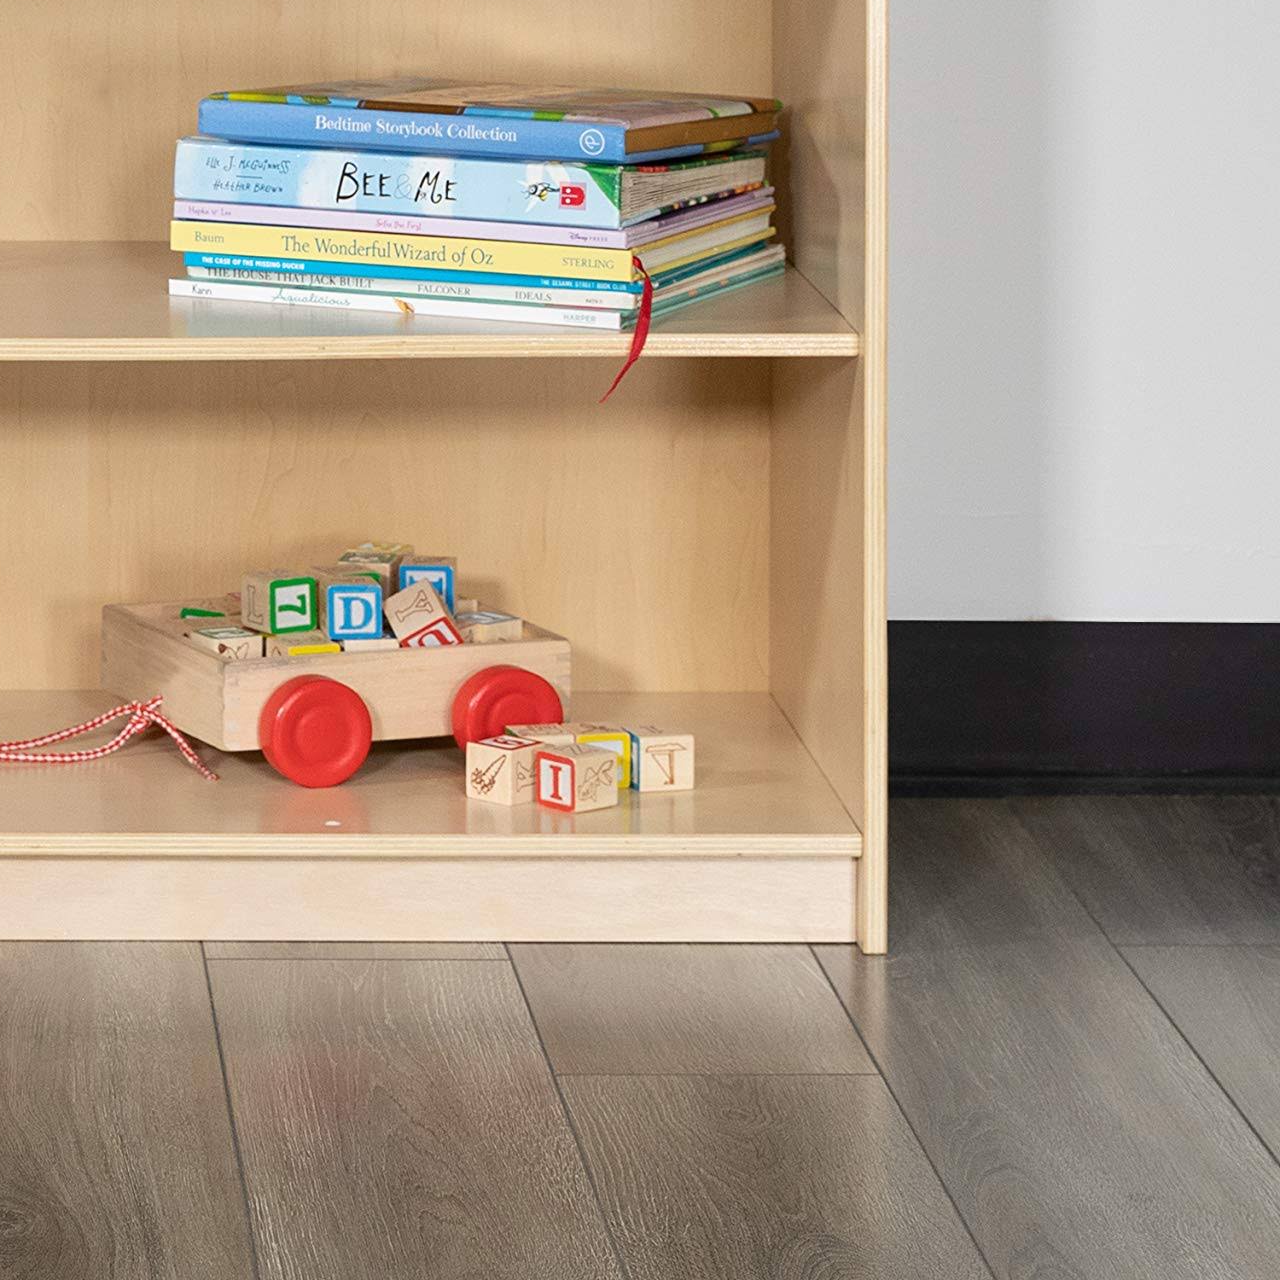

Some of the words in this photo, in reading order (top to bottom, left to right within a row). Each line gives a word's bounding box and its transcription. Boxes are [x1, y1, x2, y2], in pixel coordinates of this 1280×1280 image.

[315, 115, 371, 132] Bedtime
[376, 120, 443, 138] Storybook
[447, 123, 518, 142] Collection
[336, 162, 391, 203] BEE
[394, 174, 414, 199] &
[414, 171, 458, 203] ME
[195, 231, 225, 244] Baum
[281, 235, 310, 253] The
[314, 238, 391, 259] Wonderful
[393, 243, 447, 263] Wizard
[451, 247, 467, 267] of
[471, 248, 494, 265] Oz
[202, 256, 213, 264] THE
[214, 257, 231, 265] CASE
[232, 258, 241, 266] OF
[242, 259, 254, 267] THE
[255, 260, 281, 269] MISSING
[282, 262, 305, 270] DUCKIE
[562, 257, 614, 269] STERLING
[207, 268, 231, 277] THE
[232, 269, 272, 280] HOUSE
[274, 271, 307, 283] THAT
[308, 274, 336, 287] JACK
[338, 277, 375, 288] BUILT
[552, 279, 573, 287] SESAME
[575, 281, 595, 289] STREET
[192, 284, 212, 296] Kann
[418, 284, 471, 296] FALCONER
[515, 291, 552, 302] IDEALS
[272, 288, 351, 307] Aqualicious
[564, 314, 596, 322] HARPER
[337, 595, 374, 631] D
[548, 765, 563, 801] I
